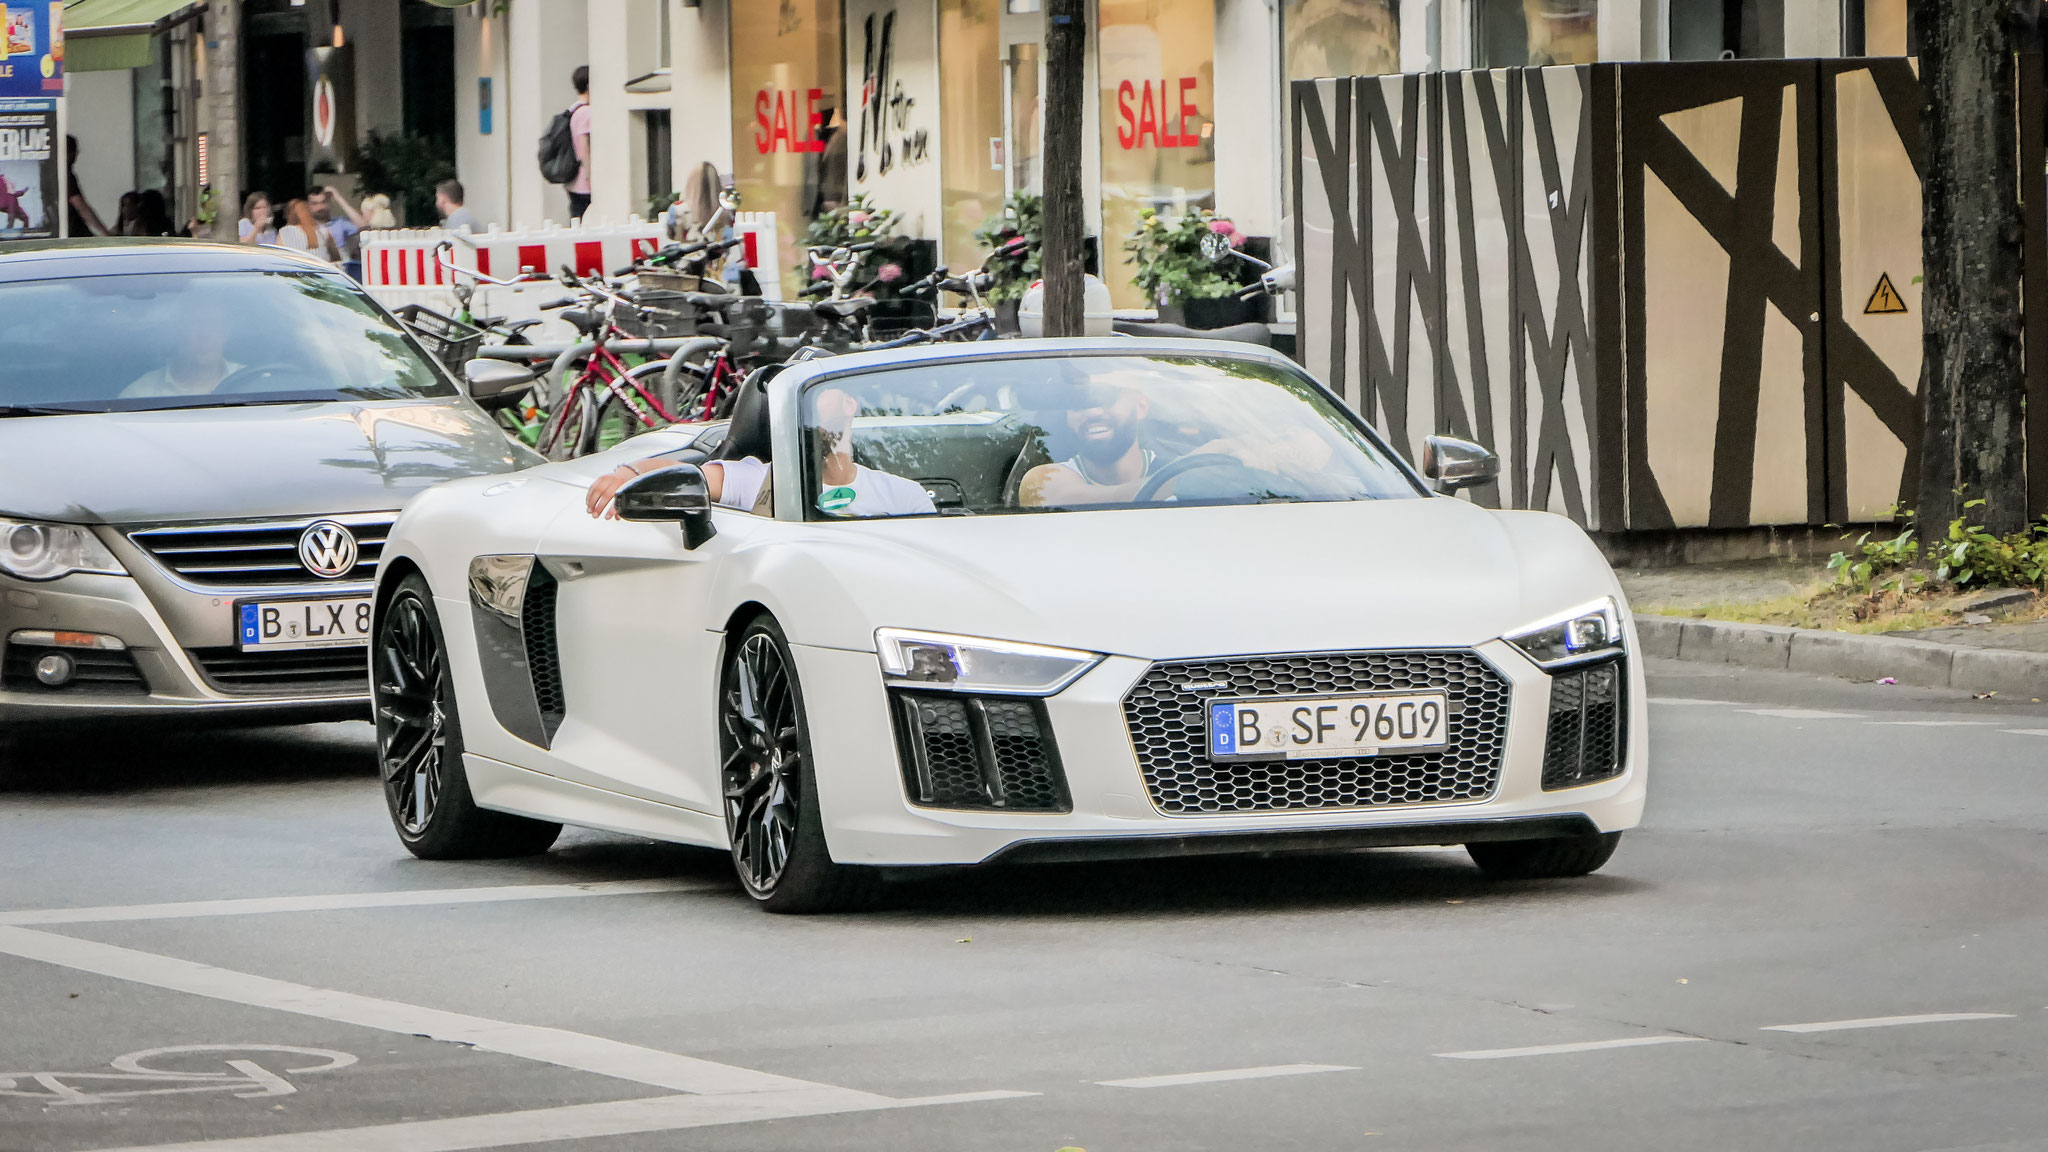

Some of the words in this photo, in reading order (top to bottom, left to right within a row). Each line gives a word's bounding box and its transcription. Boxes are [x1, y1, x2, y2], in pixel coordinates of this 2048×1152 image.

[755, 88, 825, 155] SALE
[1117, 77, 1199, 150] SALE
[832, 488, 843, 499] 4
[246, 628, 255, 638] D
[262, 607, 282, 639] B
[305, 603, 346, 637] LX
[355, 602, 370, 634] 8
[1220, 733, 1229, 745] D
[1237, 708, 1262, 747] B
[1291, 705, 1339, 745] SF
[1350, 701, 1440, 742] 9609
